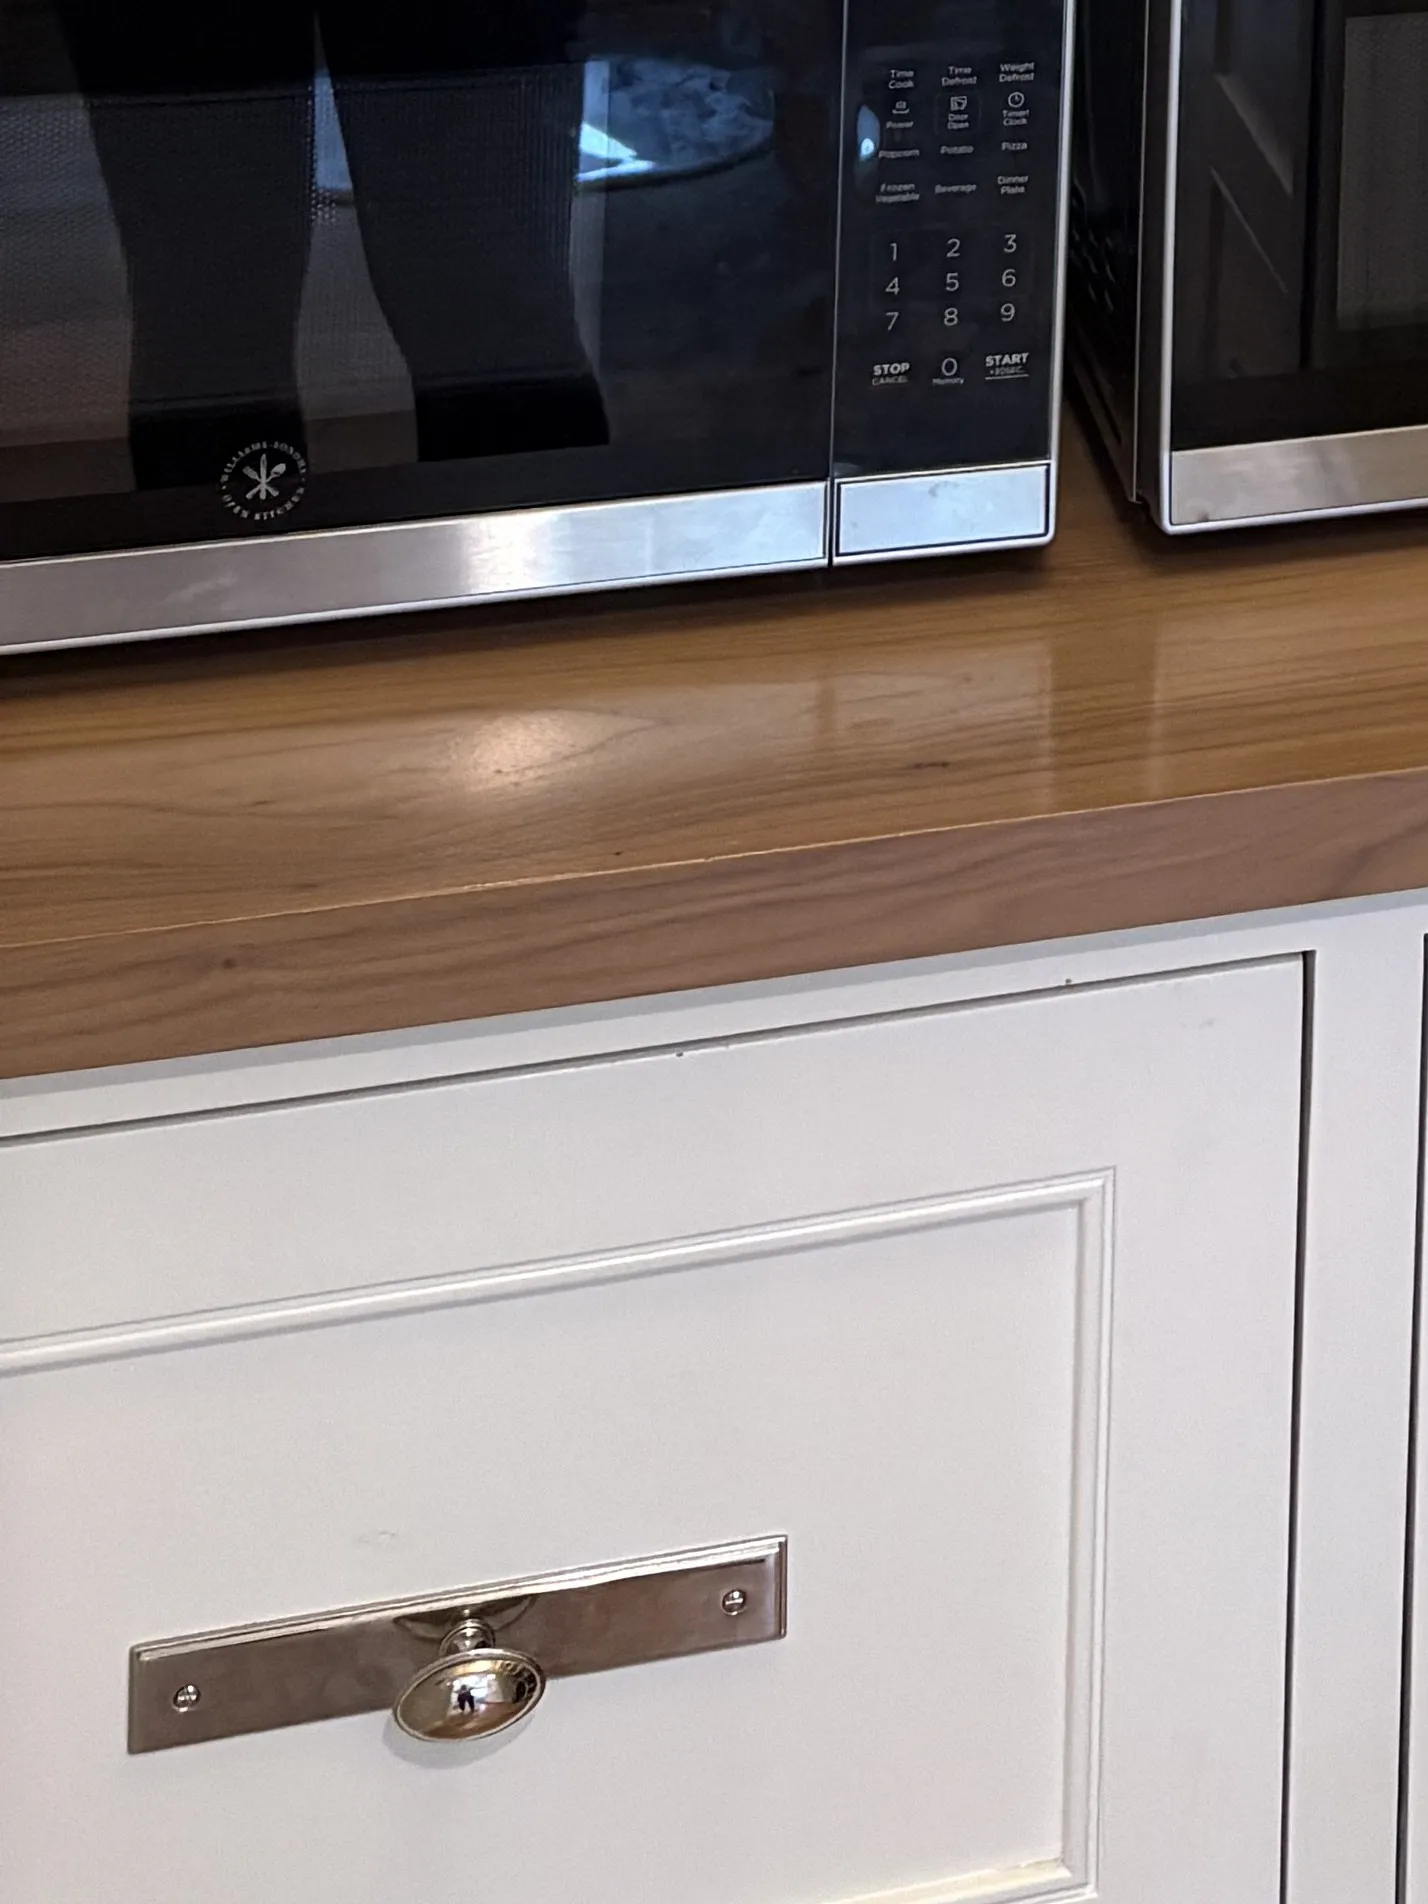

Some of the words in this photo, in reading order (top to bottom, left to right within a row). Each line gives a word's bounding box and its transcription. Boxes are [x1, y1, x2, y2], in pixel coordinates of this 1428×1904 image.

[889, 242, 898, 261] 1
[946, 238, 962, 258] 2
[1004, 233, 1018, 254] 3
[885, 275, 901, 296] 4
[946, 272, 960, 292] 5
[1002, 268, 1016, 289] 6
[885, 312, 900, 332] 7
[944, 307, 959, 327] 8
[1001, 302, 1015, 323] 9
[872, 360, 911, 376] STOP
[941, 356, 958, 378] 0
[985, 352, 1030, 369] START
